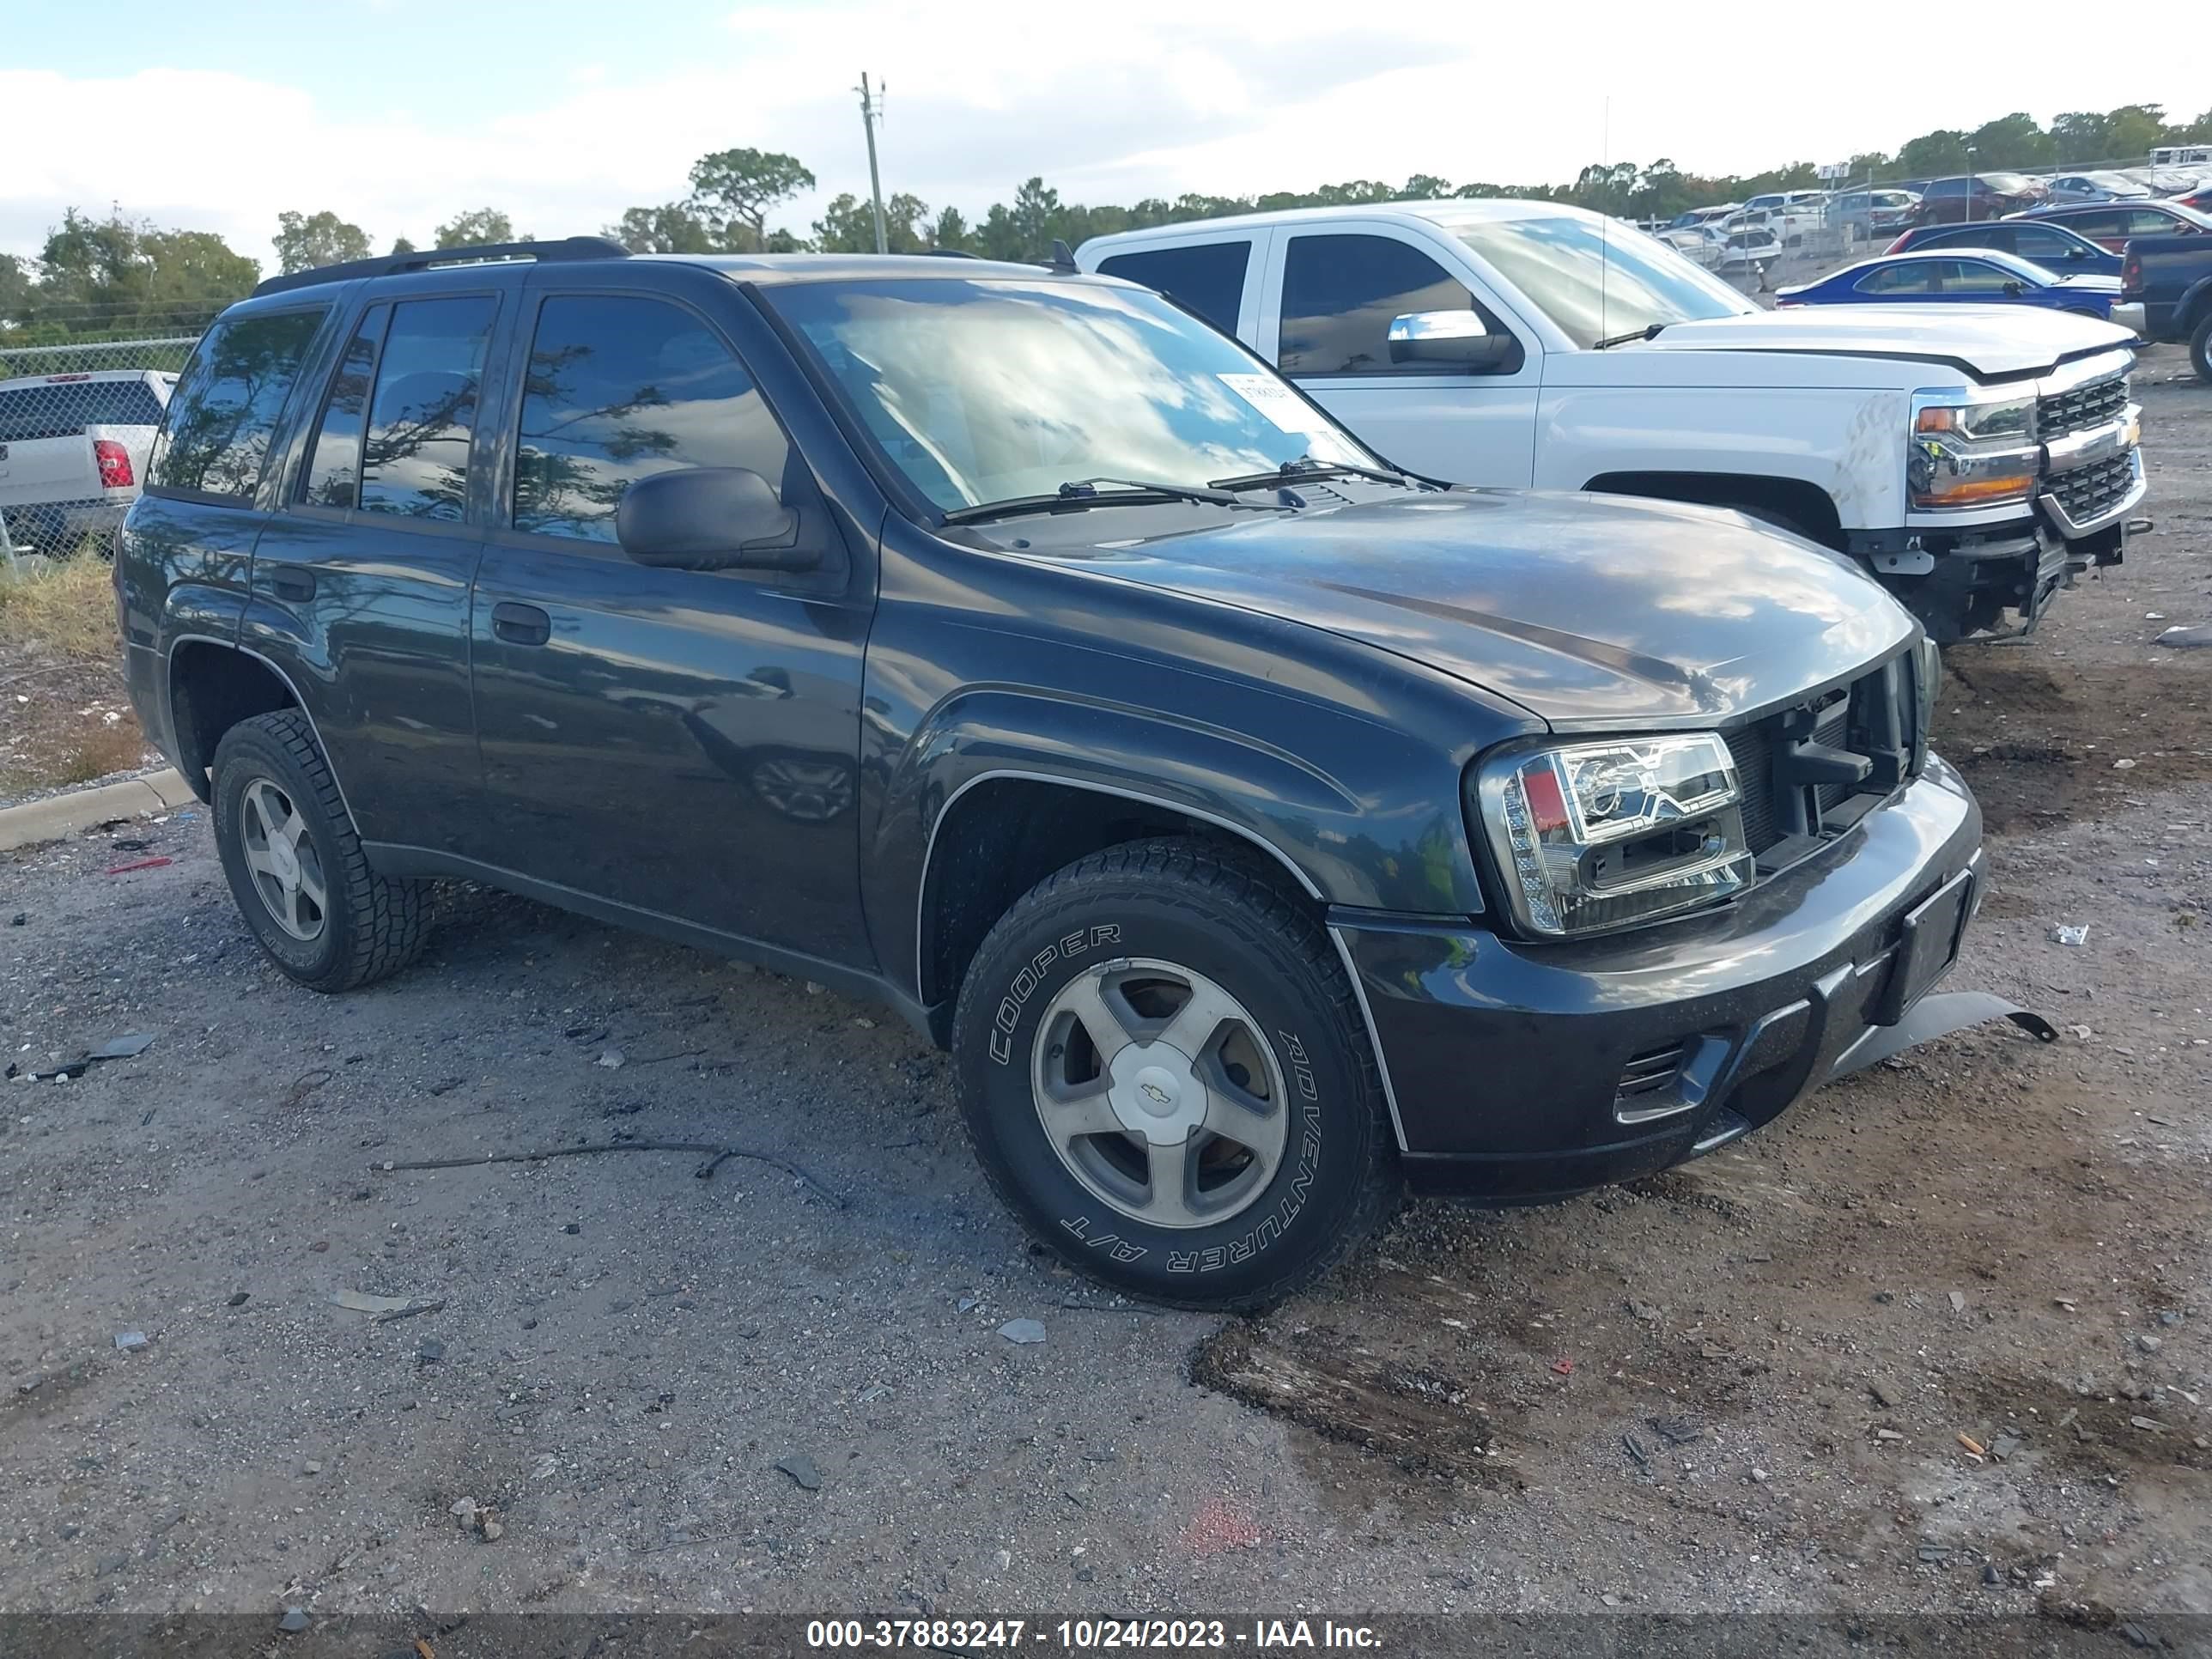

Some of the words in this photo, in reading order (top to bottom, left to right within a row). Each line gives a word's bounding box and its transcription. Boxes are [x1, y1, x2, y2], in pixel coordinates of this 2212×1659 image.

[989, 924, 1121, 1066] COOPER
[1166, 1030, 1322, 1273] ADVENTURER
[1060, 1216, 1149, 1263] A/T
